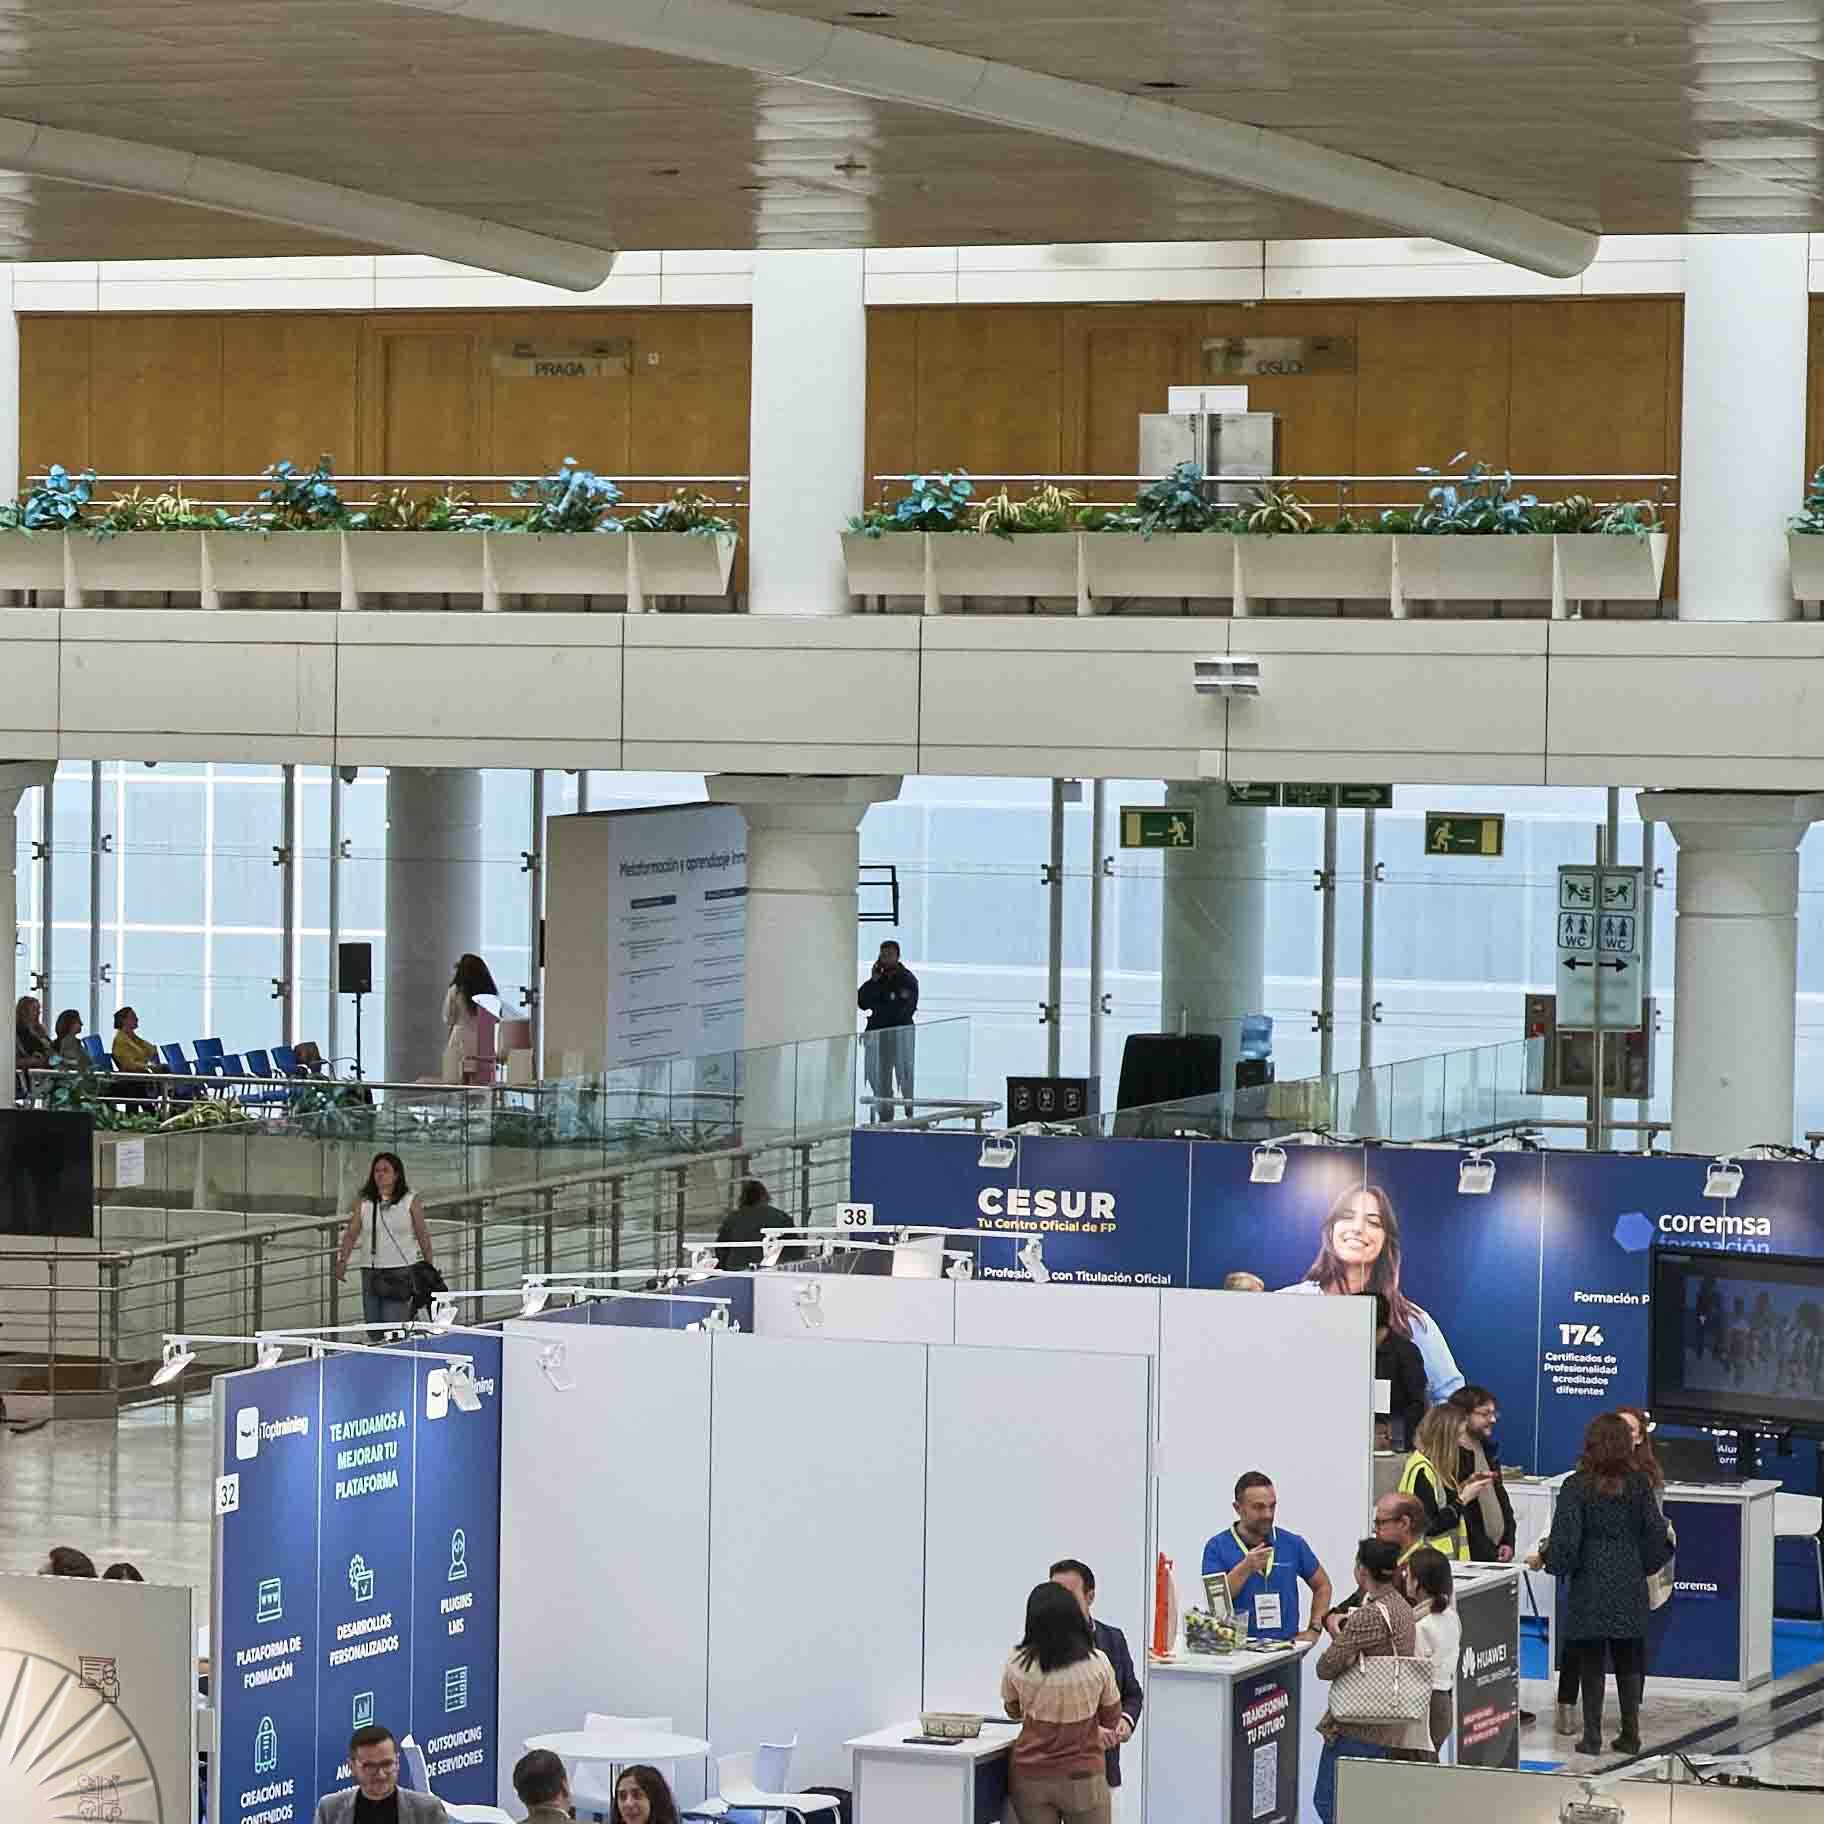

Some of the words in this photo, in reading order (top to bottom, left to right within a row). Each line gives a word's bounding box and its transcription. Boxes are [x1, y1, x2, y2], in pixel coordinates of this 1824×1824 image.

[1565, 936, 1587, 948] WC
[1606, 938, 1627, 950] WC
[977, 1186, 1116, 1220] CESUR
[843, 1208, 868, 1227] 38
[977, 1217, 993, 1230] Tu
[994, 1219, 1038, 1232] Centro
[1039, 1219, 1080, 1233] Oficial
[1081, 1222, 1098, 1233] de
[1658, 1214, 1772, 1237] coremsa
[1051, 1273, 1074, 1283] con
[1075, 1270, 1133, 1284] Titulación
[1134, 1273, 1172, 1286] Oficial
[1573, 1291, 1640, 1306] Formación
[1559, 1323, 1605, 1347] 174
[1545, 1351, 1602, 1364] Certificados
[1544, 1363, 1618, 1376] Profesionalidad
[337, 1445, 380, 1470] MEJORAR
[220, 1482, 236, 1506] 32
[335, 1473, 399, 1501] PLATAFORMA
[1674, 1580, 1718, 1592] coremsa
[236, 1640, 287, 1668] PLATAFORMA
[1476, 1644, 1508, 1671] HUAWEI
[243, 1661, 294, 1690] FORMACIÓN
